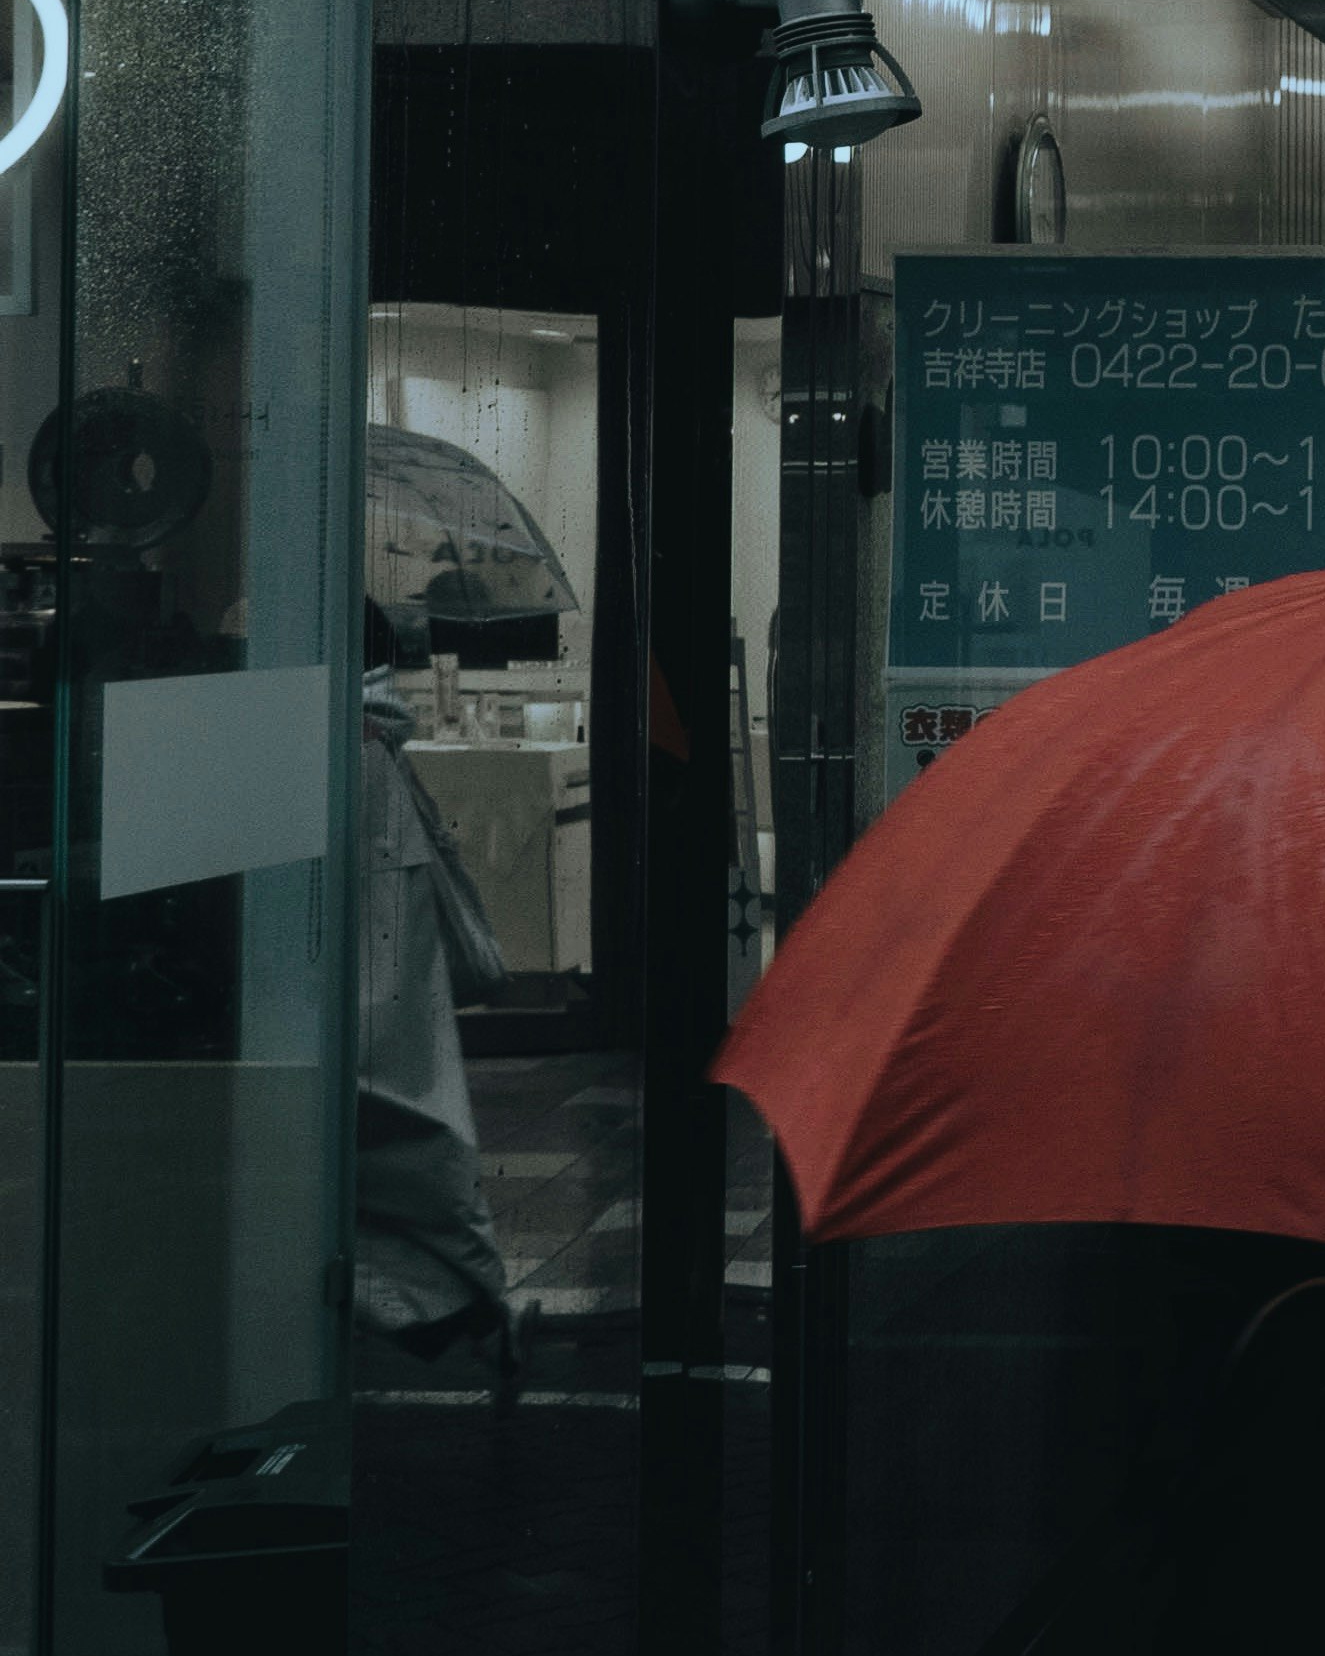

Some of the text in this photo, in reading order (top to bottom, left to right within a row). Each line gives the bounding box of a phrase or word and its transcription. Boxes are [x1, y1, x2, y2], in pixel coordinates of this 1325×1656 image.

[921, 298, 1258, 339] クリーニングショップ
[923, 349, 1046, 390] 吉祥寺店
[920, 440, 1058, 482] 営業時間
[920, 489, 1058, 531] 休憩時間
[919, 581, 1068, 623] 定休日
[902, 704, 998, 745] 衣類
